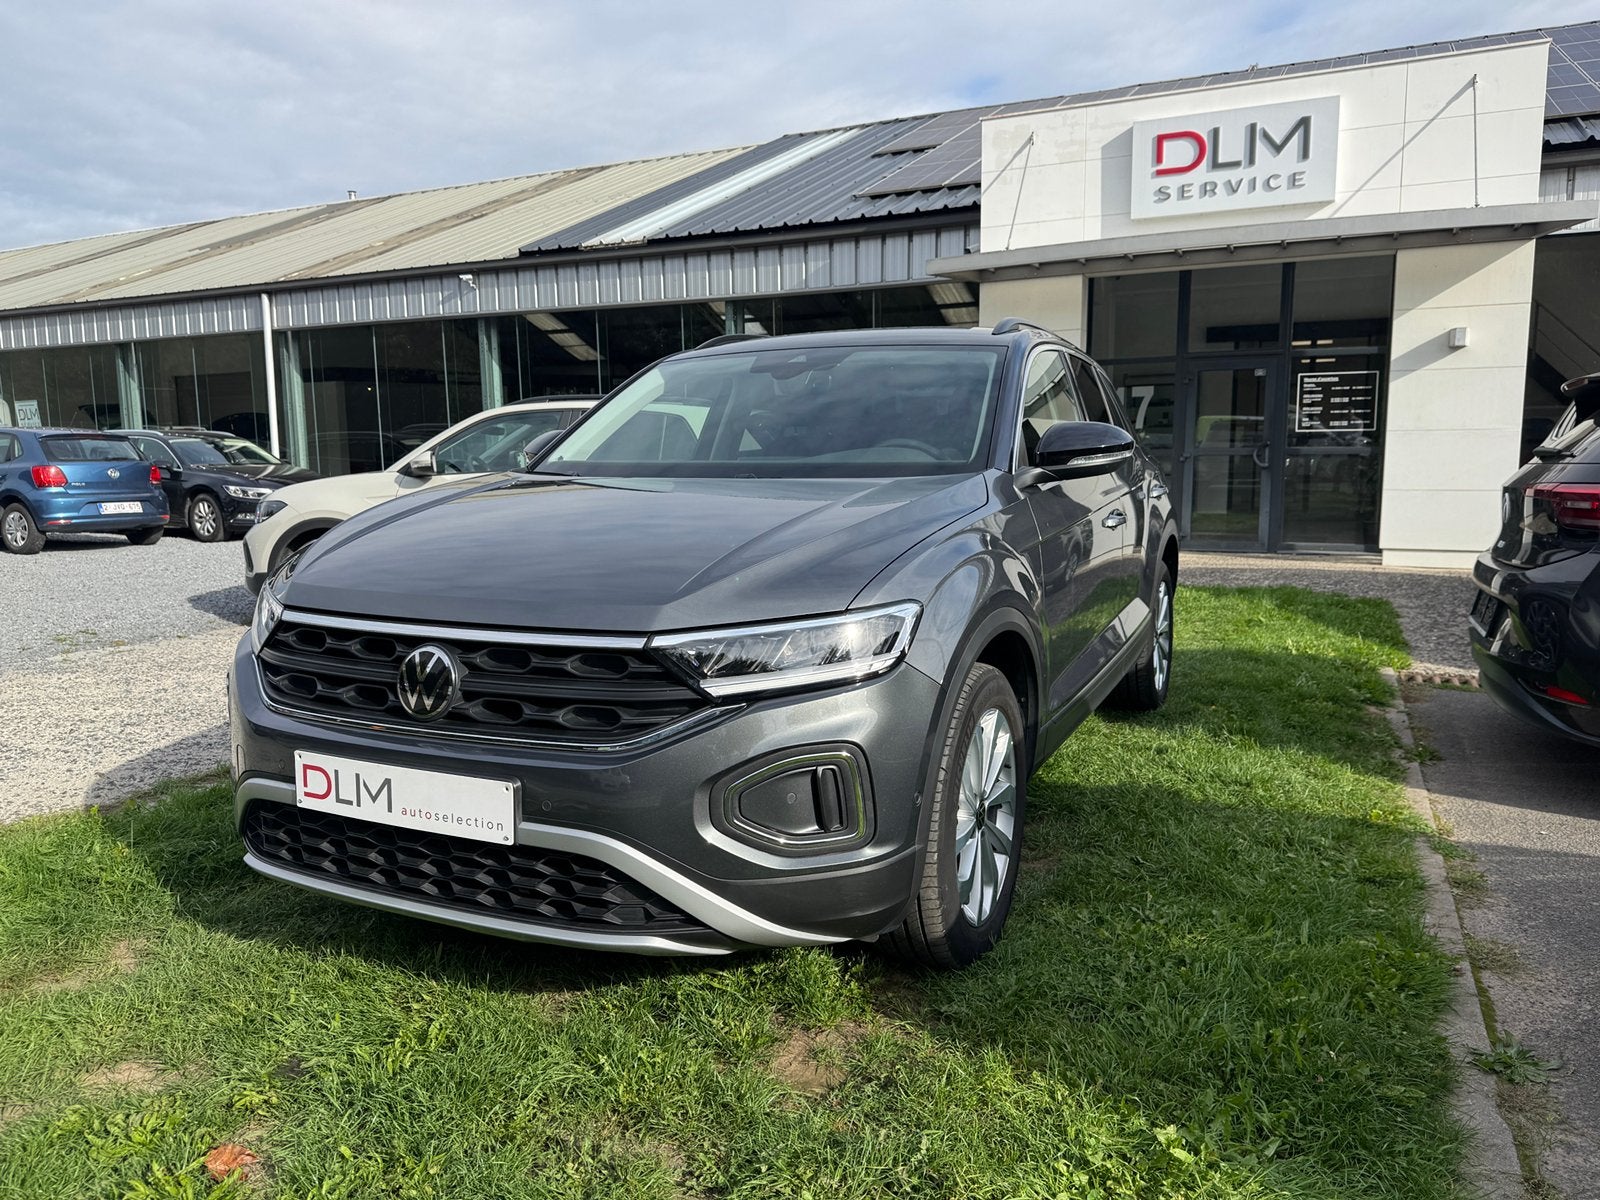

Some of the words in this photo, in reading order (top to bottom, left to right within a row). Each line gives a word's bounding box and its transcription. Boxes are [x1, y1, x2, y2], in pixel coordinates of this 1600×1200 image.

[1155, 115, 1312, 177] DLM
[1154, 170, 1307, 202] SERVICE
[302, 763, 393, 814] DLM
[401, 806, 504, 832] autoselection
